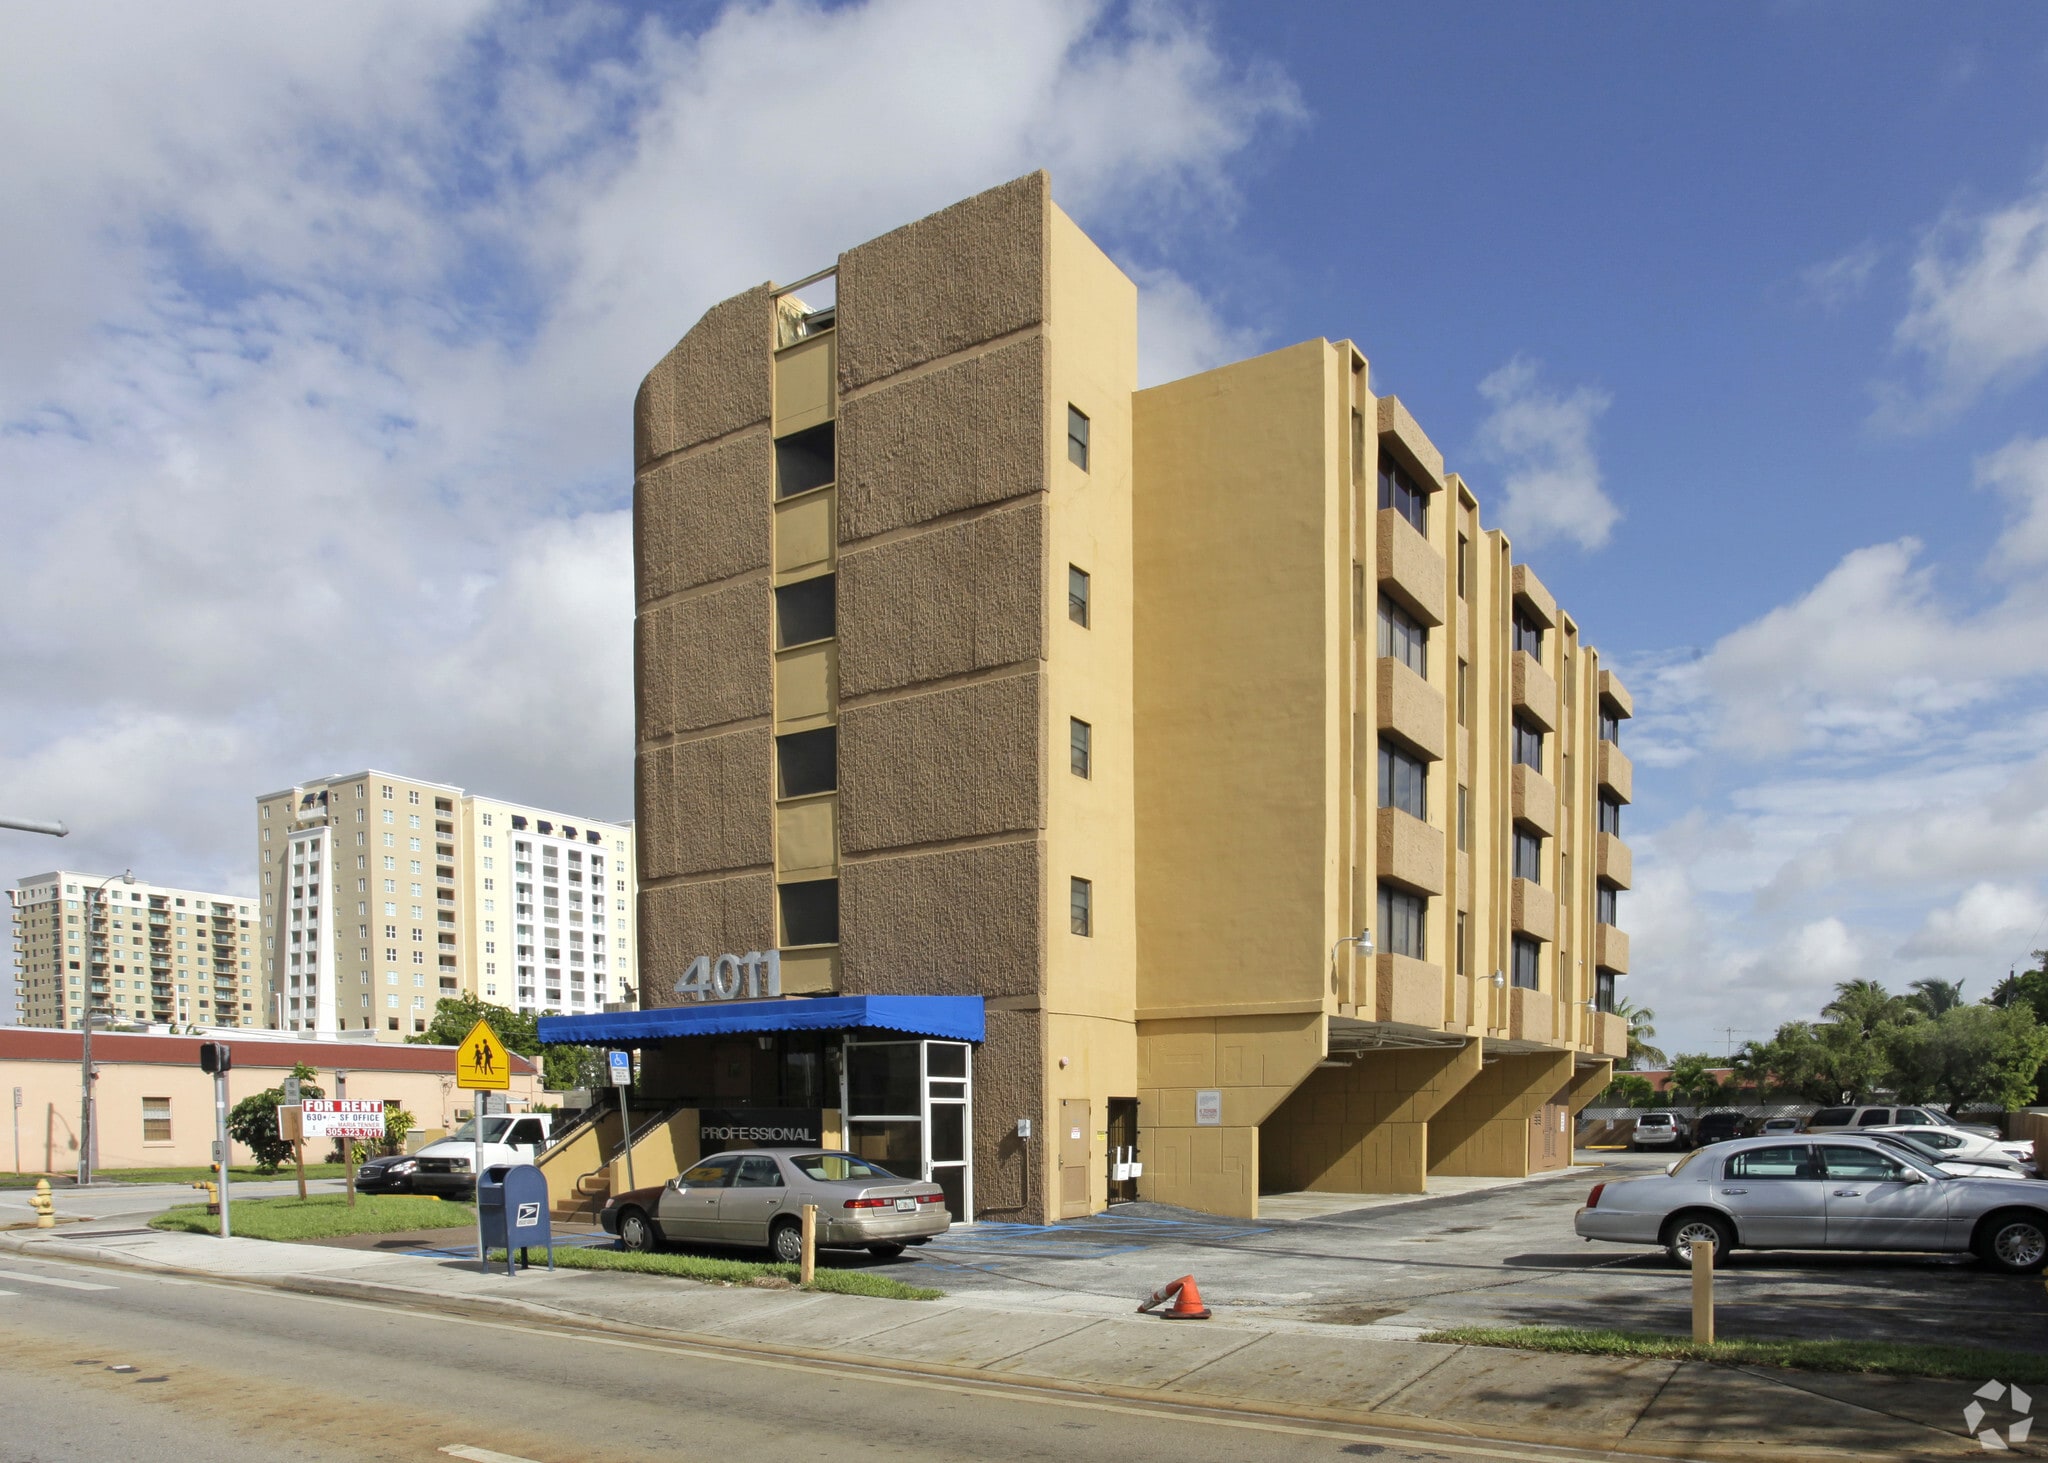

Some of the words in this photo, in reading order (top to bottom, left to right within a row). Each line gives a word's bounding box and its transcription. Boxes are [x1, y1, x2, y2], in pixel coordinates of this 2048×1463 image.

[674, 949, 780, 1001] 4011
[305, 1101, 334, 1111] FOR
[341, 1101, 381, 1112] RENT
[701, 1127, 817, 1142] PROFESSIONAL
